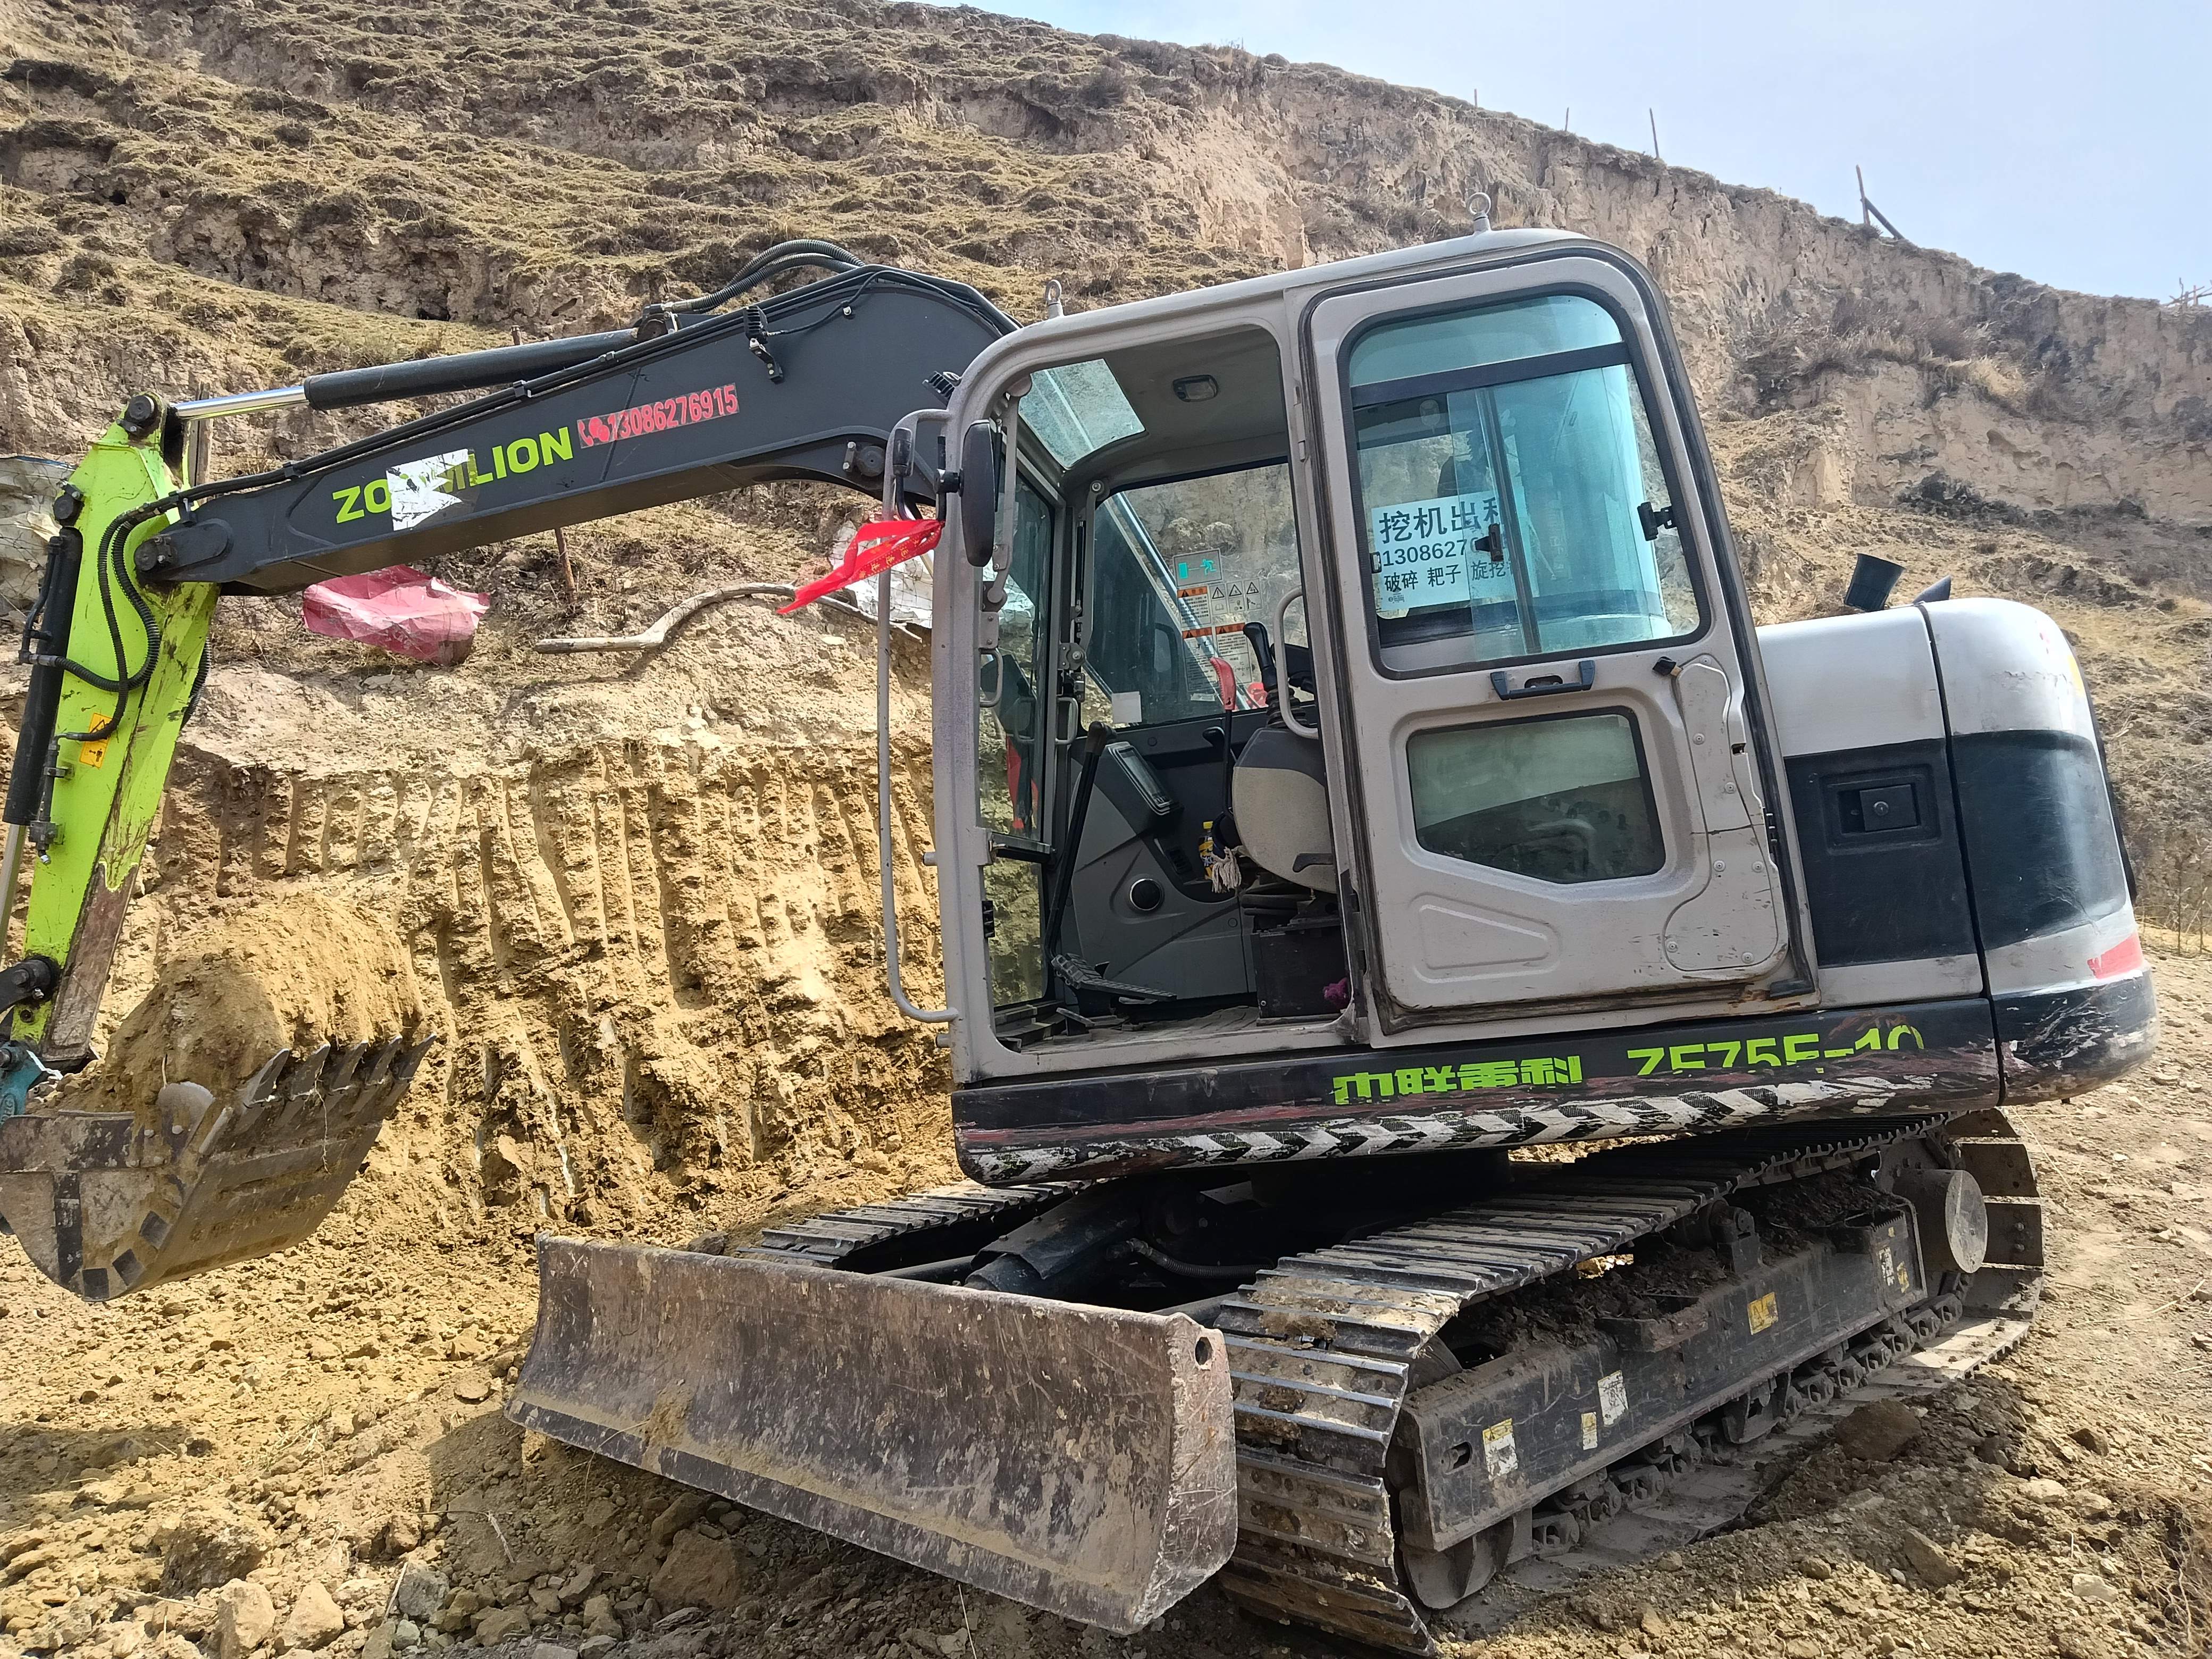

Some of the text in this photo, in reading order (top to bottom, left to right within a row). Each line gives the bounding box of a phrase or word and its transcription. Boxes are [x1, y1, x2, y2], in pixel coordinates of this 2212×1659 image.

[608, 384, 738, 440] 13086276915
[332, 426, 573, 524] ZOLION
[1384, 569, 1419, 592] 破碎
[1427, 564, 1461, 588] 耙子
